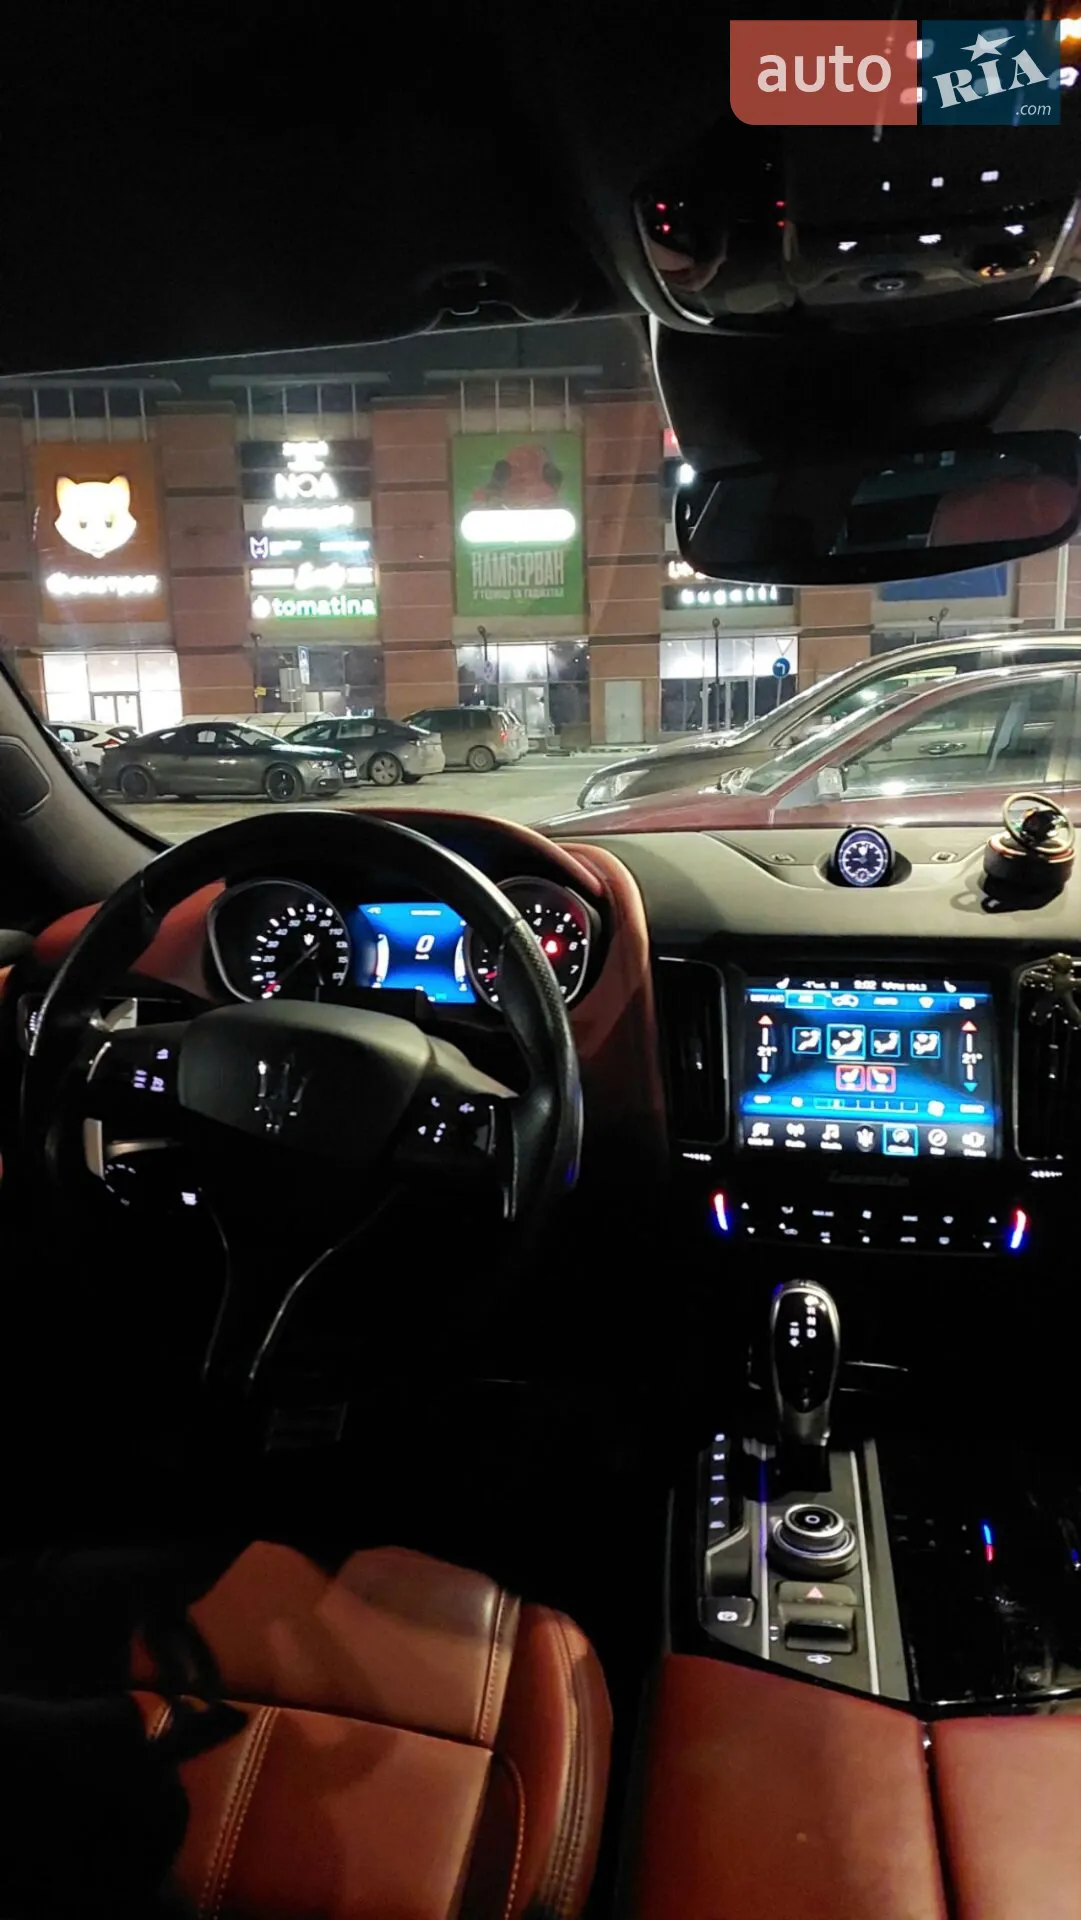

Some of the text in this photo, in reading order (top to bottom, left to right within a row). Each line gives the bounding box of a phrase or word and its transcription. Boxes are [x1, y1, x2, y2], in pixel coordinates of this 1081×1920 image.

[274, 472, 339, 500] NOA
[472, 549, 565, 587] НАМБЕРВАН
[271, 595, 377, 617] tomatina
[415, 934, 435, 953] 0
